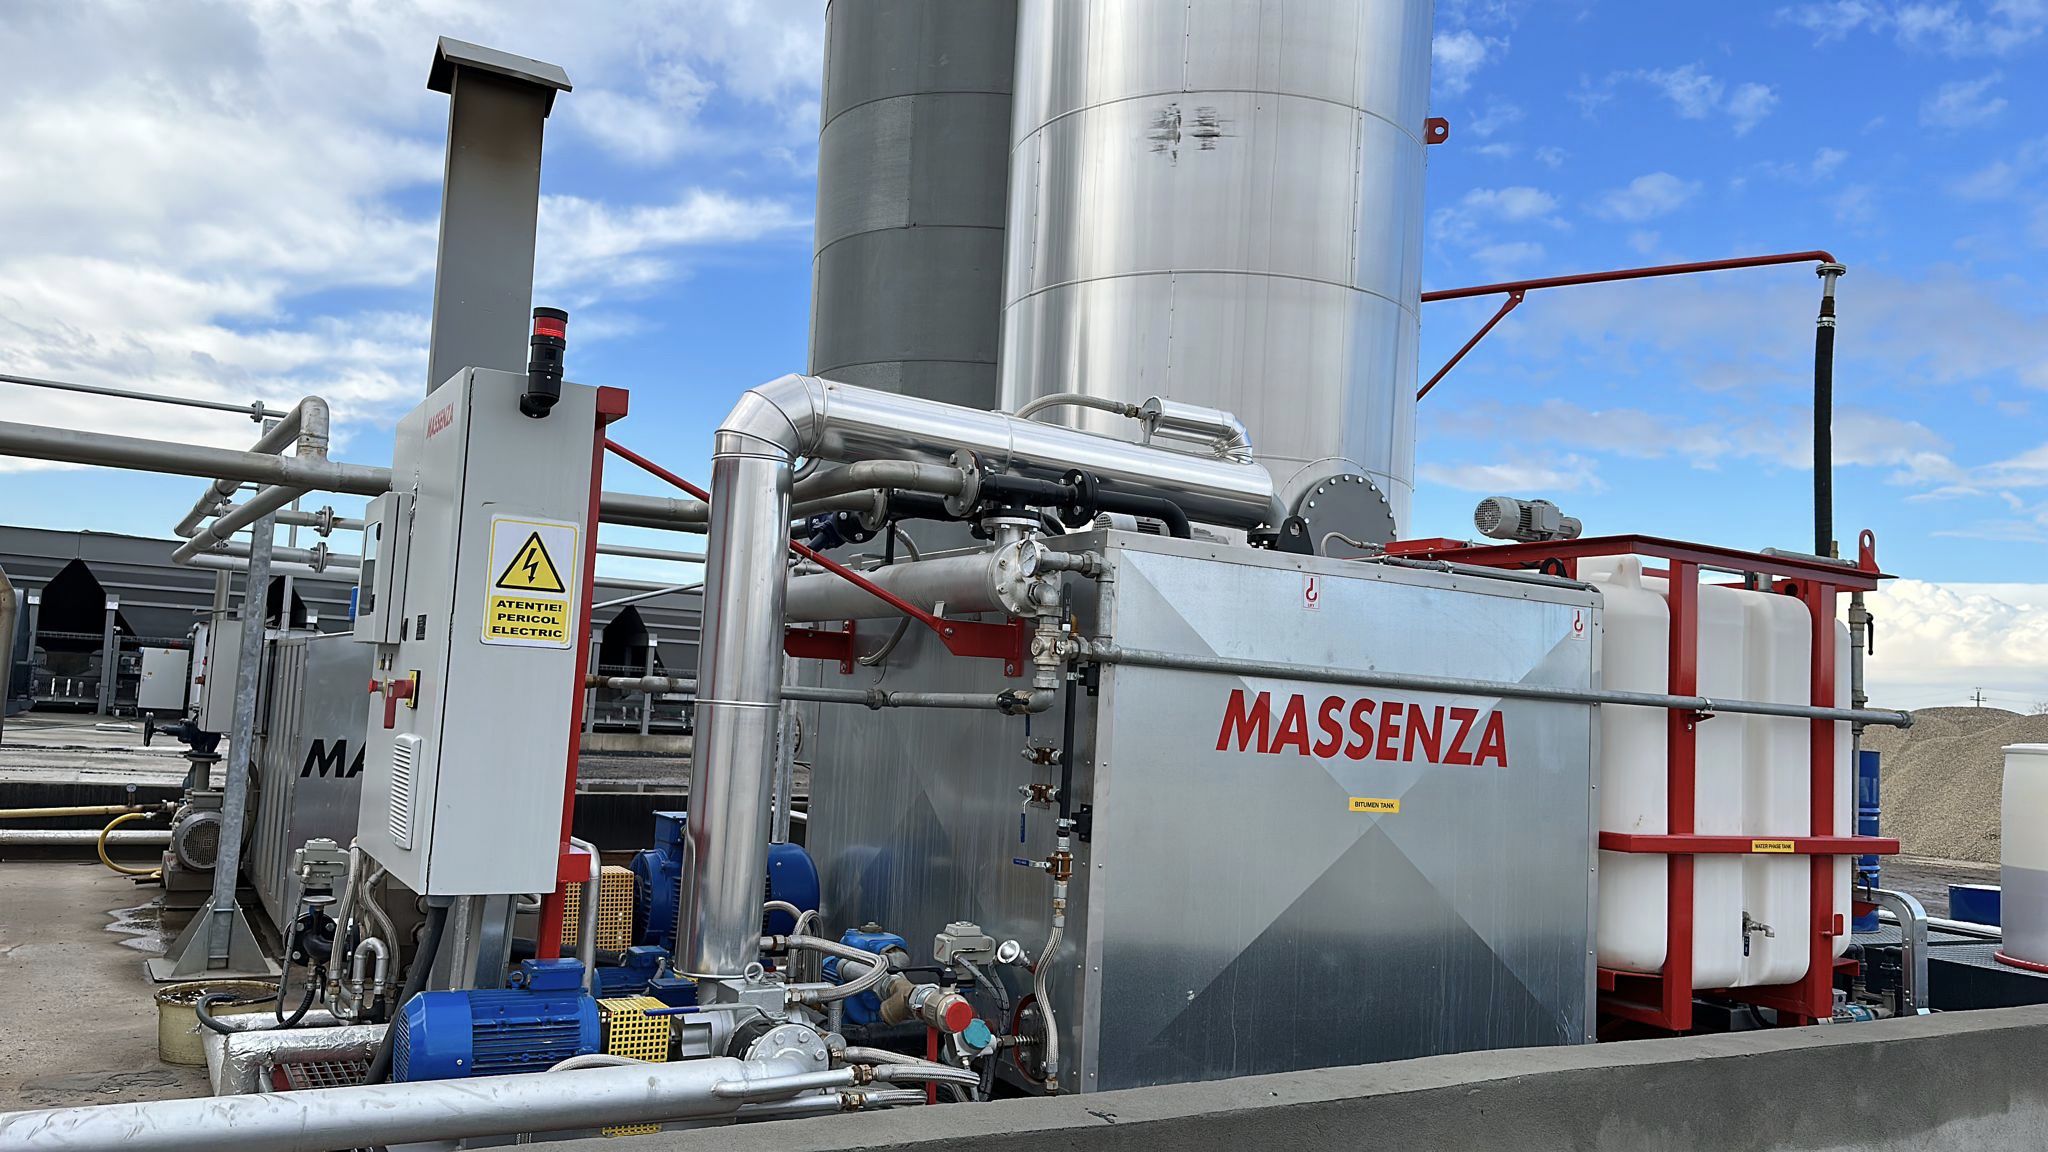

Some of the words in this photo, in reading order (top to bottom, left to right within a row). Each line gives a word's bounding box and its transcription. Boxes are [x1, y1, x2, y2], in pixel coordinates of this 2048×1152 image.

[497, 613, 560, 625] PERICOL
[492, 626, 563, 638] ELECTRIC
[1215, 688, 1508, 768] MASSENZA
